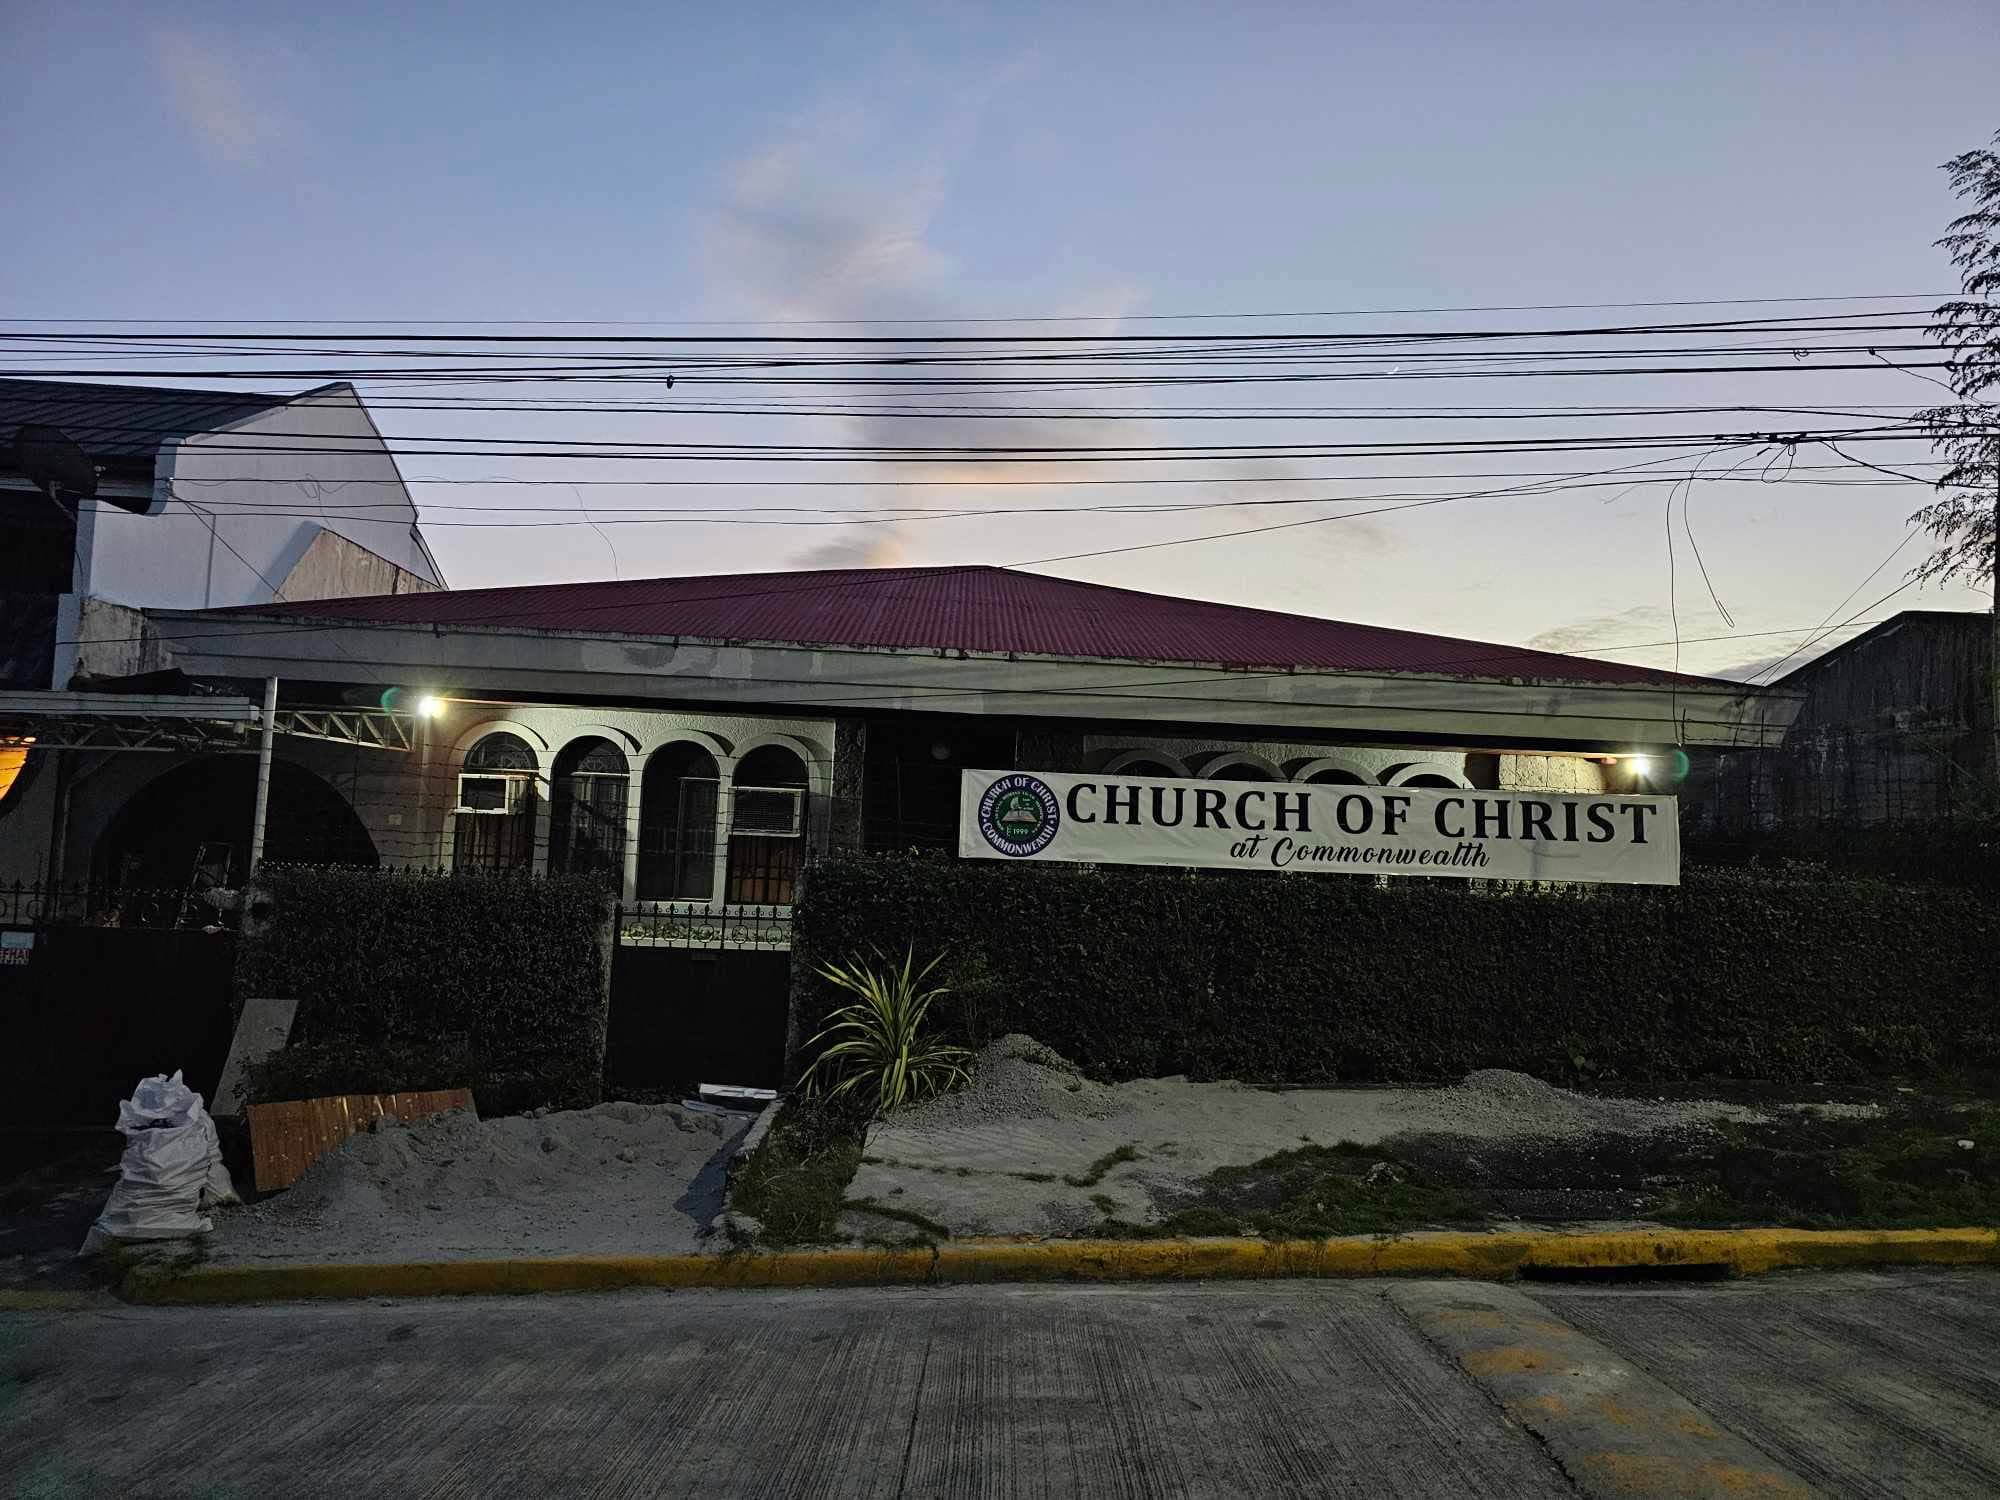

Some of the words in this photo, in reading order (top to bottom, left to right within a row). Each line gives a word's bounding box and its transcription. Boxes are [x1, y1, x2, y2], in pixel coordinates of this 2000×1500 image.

[981, 778, 1011, 818] CHURCH
[1014, 776, 1029, 787] OF
[1030, 781, 1057, 819] CHRIST
[1066, 783, 1312, 832] CHURCH
[1336, 793, 1411, 835] OF
[1434, 797, 1656, 844] CHRIST
[982, 823, 1055, 854] COMMONWEALTH
[1230, 834, 1268, 858] at
[1270, 836, 1491, 868] Commonwealth
